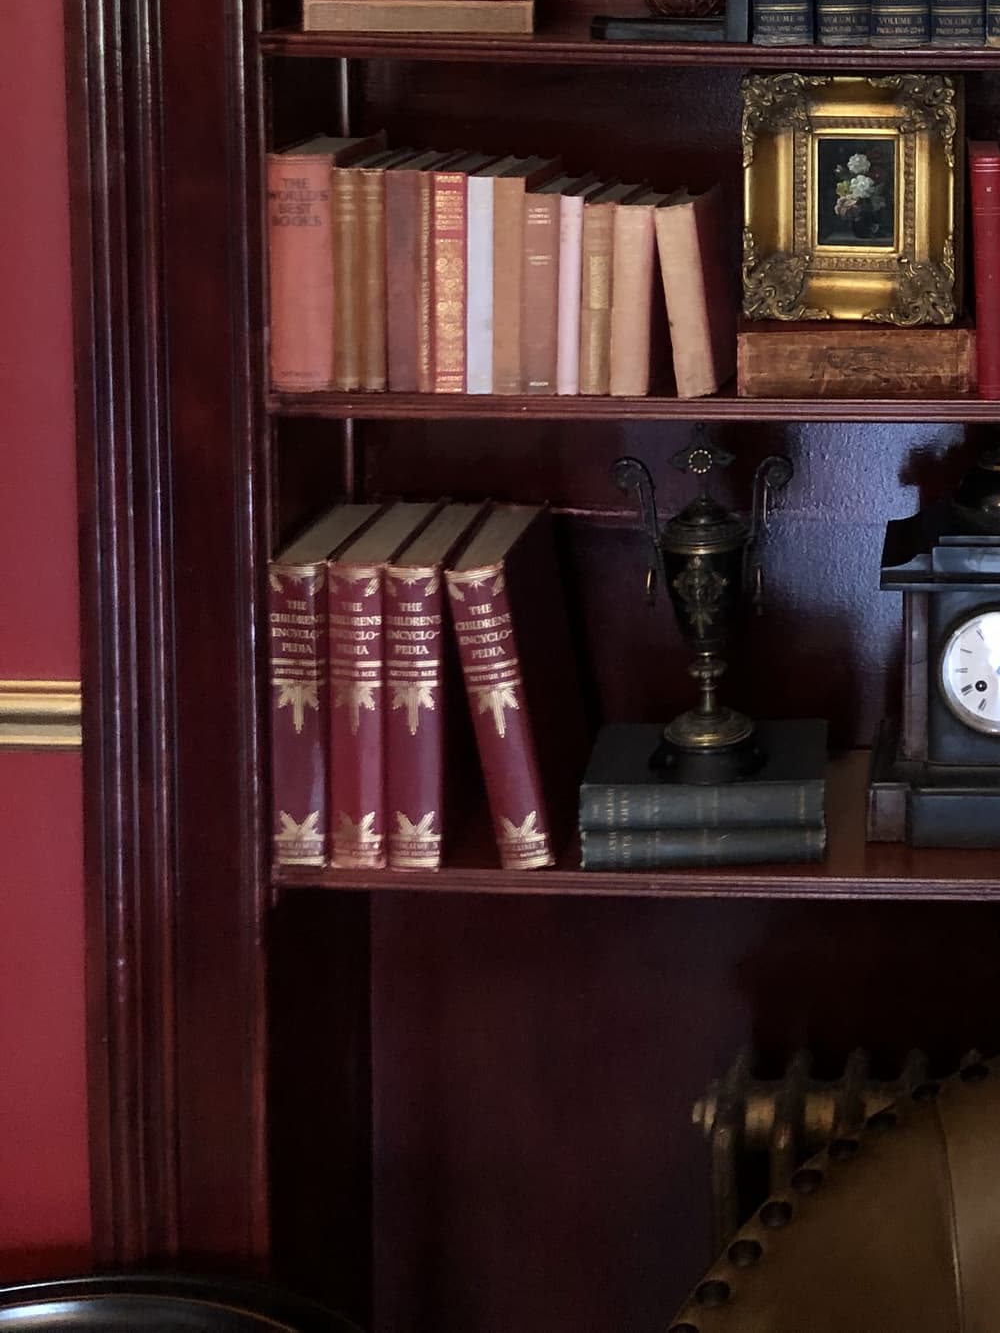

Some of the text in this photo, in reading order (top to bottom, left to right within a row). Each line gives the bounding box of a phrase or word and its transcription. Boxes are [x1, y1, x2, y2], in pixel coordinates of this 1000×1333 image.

[281, 177, 310, 189] THE
[268, 190, 329, 202] WORLD'S
[279, 203, 312, 215] BEST
[271, 216, 323, 227] BOOKS
[287, 600, 307, 611] THE
[400, 602, 423, 612] THE
[467, 603, 493, 616] THE
[455, 612, 512, 632] CHILDREN'S
[459, 629, 513, 646] ENCYCLO-
[282, 642, 313, 655] PEDIA
[395, 644, 430, 655] PEDIA
[471, 646, 506, 660] PEDIA
[421, 669, 437, 677] MEE
